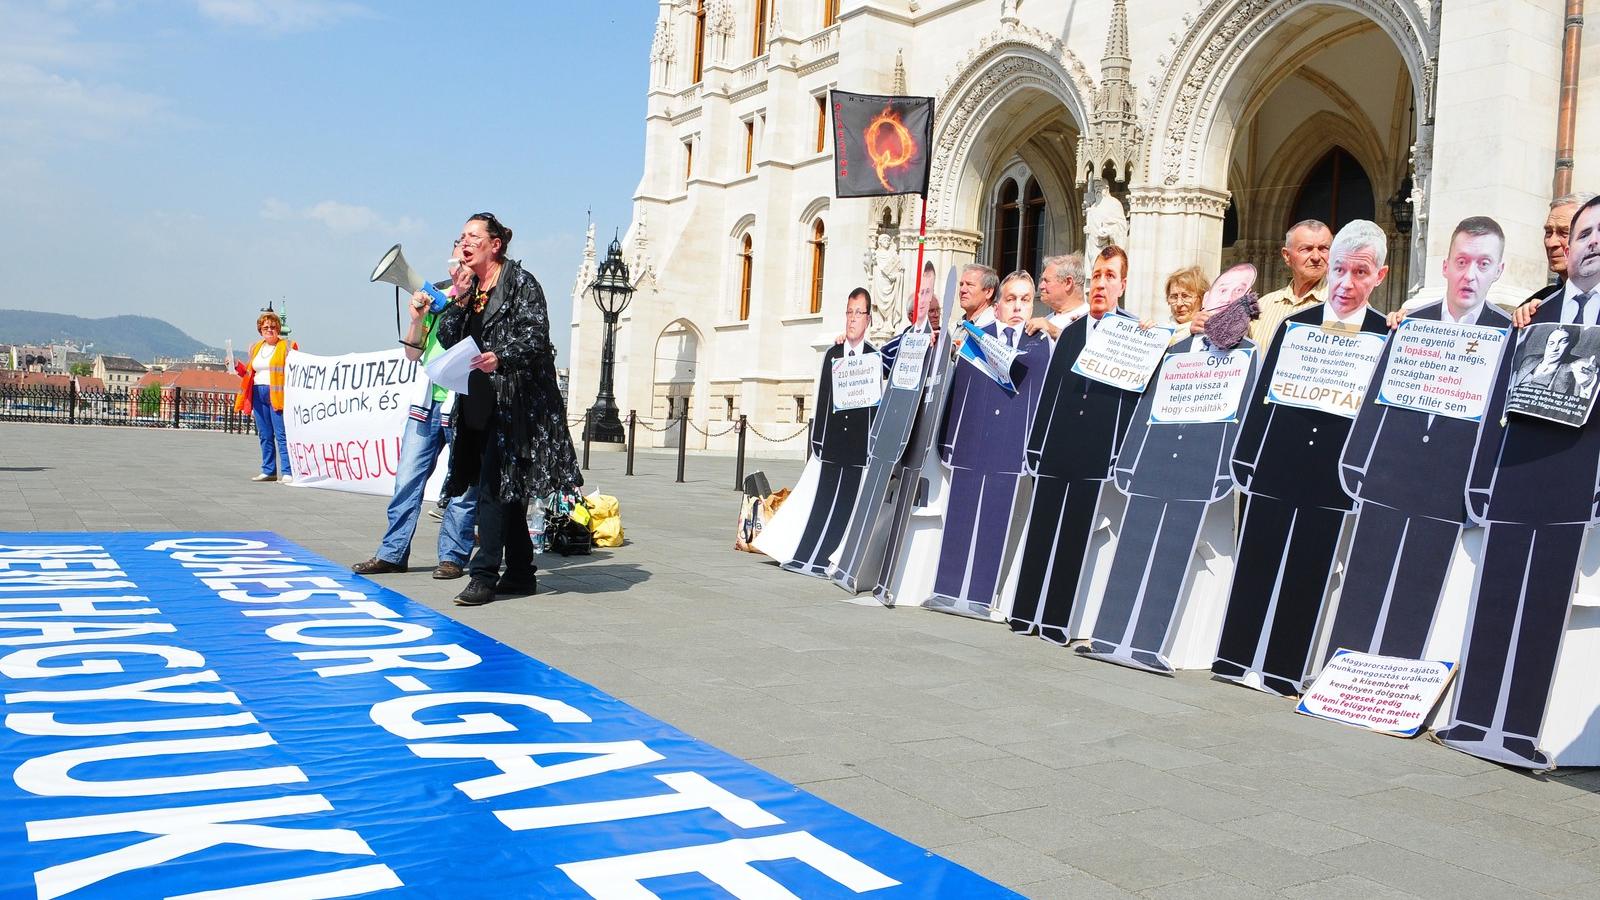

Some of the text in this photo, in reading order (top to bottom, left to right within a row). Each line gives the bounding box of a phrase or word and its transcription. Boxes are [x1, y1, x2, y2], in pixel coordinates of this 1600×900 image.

[1116, 321, 1133, 333] Polt
[1413, 323, 1459, 336] befektetési
[1461, 330, 1501, 342] kockázat
[1307, 331, 1329, 344] Polt
[1401, 334, 1455, 348] nem egyenlő
[848, 359, 858, 367] Hol
[1301, 354, 1318, 363] több
[1344, 352, 1378, 363] keresztü
[1404, 345, 1442, 359] lopással,
[1444, 352, 1456, 360] ha
[1458, 354, 1487, 366] mégis,
[1301, 364, 1319, 374] nagy
[1394, 356, 1459, 373] akkor ebben az
[287, 363, 299, 387] MI
[298, 365, 326, 390] NEM
[1165, 369, 1241, 380] kamatokkal együtt
[1276, 369, 1312, 381] készpénzt
[1391, 368, 1462, 386] országban sehol
[1170, 383, 1193, 392] kapta
[1195, 382, 1221, 390] vissza
[1388, 378, 1482, 401] nincsen biztonságban
[1170, 394, 1191, 403] teljes
[1396, 393, 1467, 412] egy fillér sem
[294, 390, 400, 426] Maradunk, és
[1161, 403, 1228, 415] Hogy csinálták?
[289, 442, 321, 478] NEM
[1328, 664, 1443, 684] munkamegosztás uralkodik:
[1341, 657, 1439, 675] Magyarországon sajátos
[1329, 680, 1422, 701] keményen dolgoznak,
[1359, 677, 1410, 690] kisemberek
[1311, 693, 1420, 719] állami felügyelet mellett
[1339, 692, 1402, 708] egyesek pedig
[1321, 705, 1400, 726] keményen lopnak.
